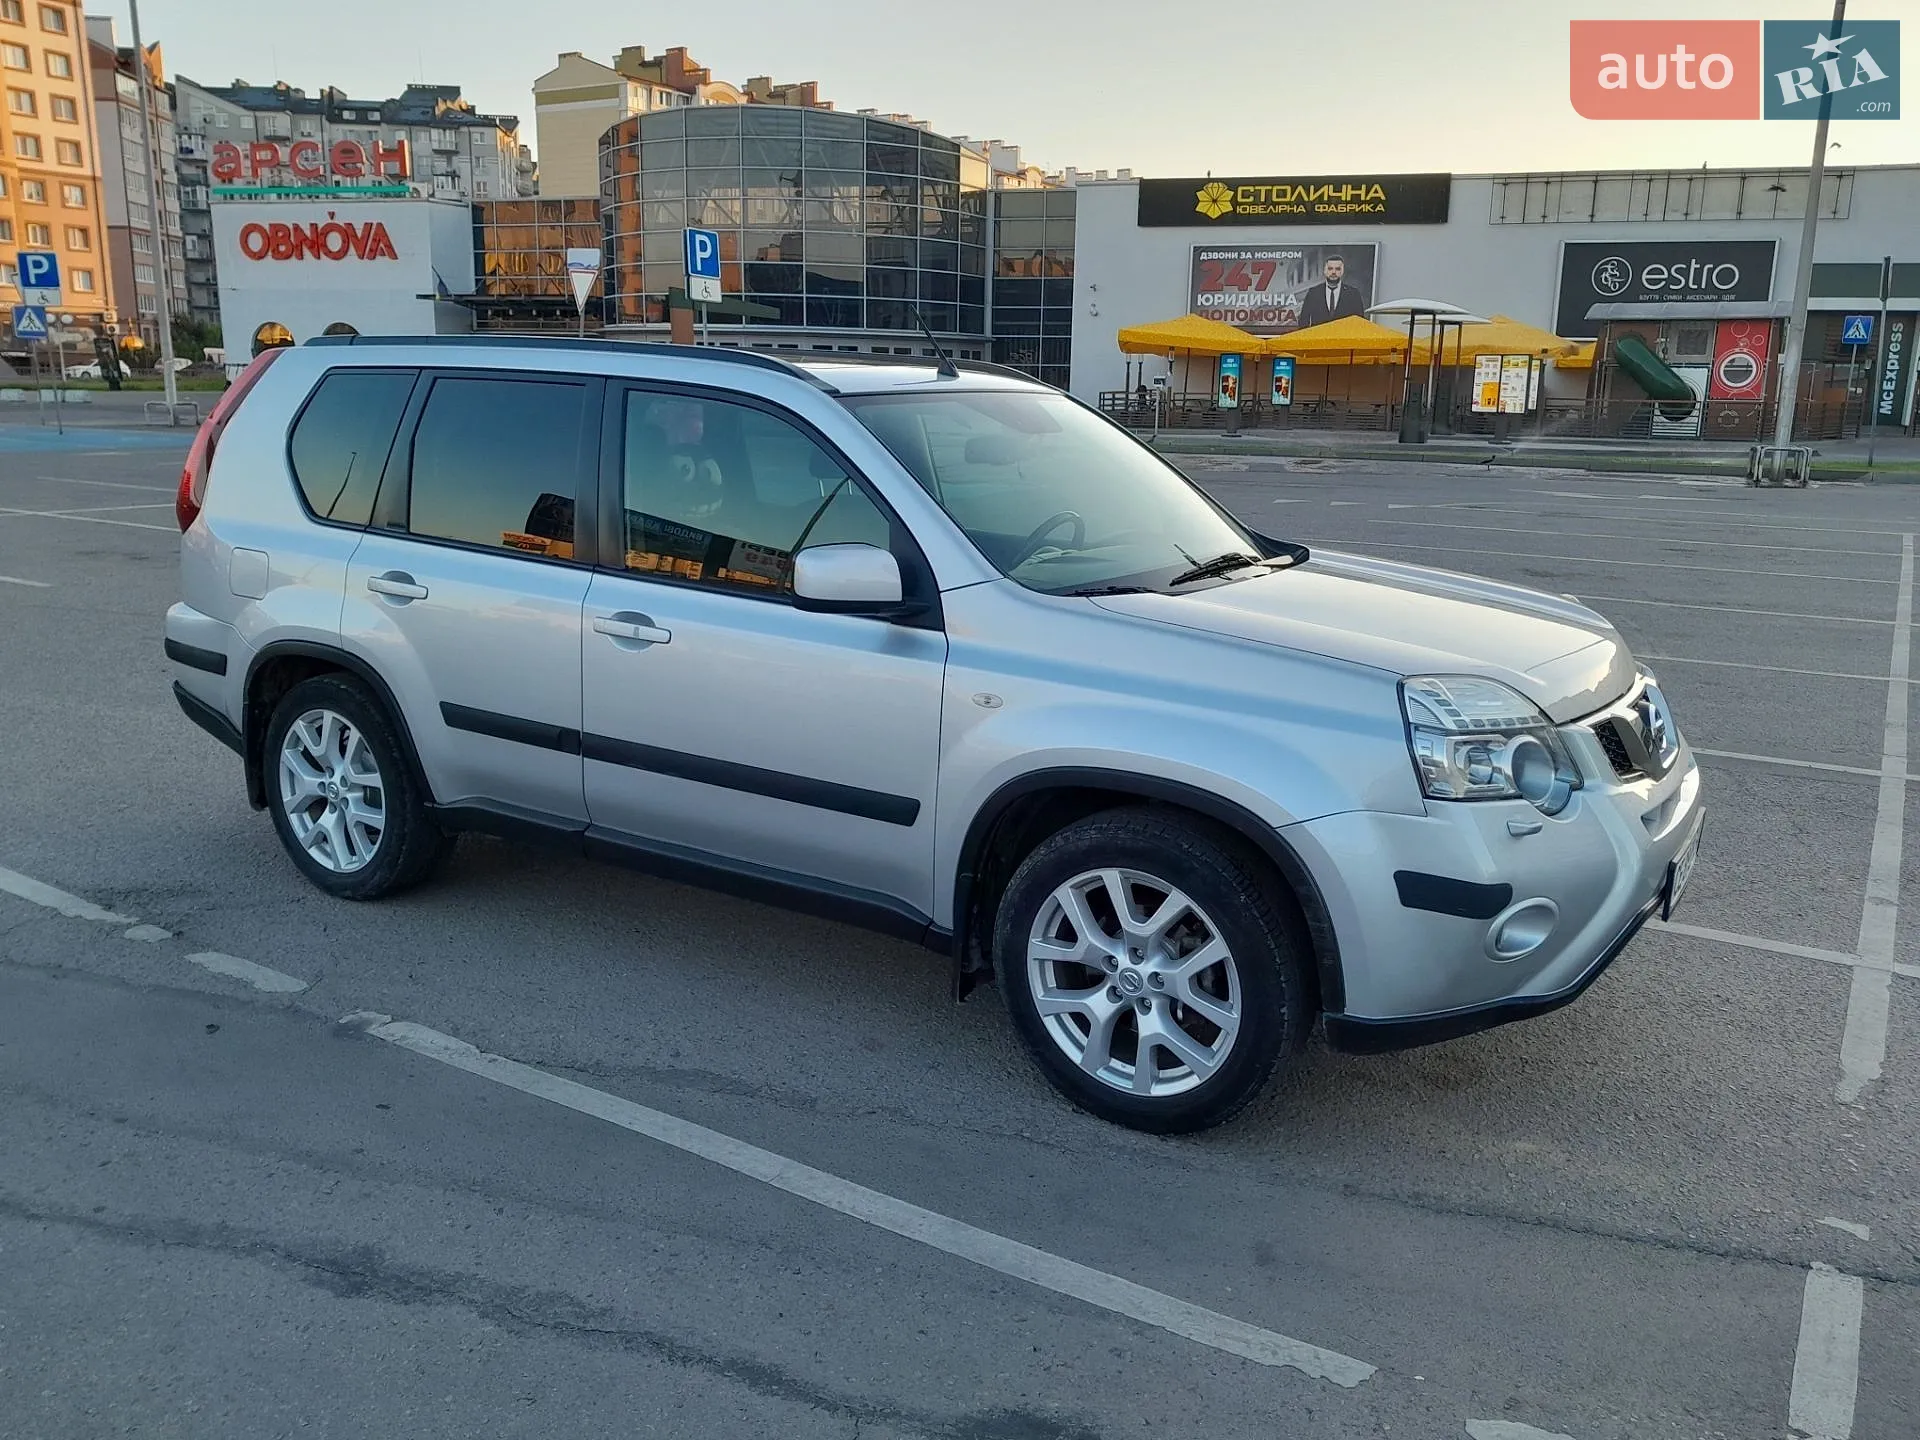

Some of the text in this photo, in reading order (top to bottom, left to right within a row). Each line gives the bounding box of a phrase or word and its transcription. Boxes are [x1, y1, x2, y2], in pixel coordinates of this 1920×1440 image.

[1236, 183, 1387, 203] СТОЛИЧНА
[1236, 203, 1386, 214] ЮВЕЛІРНА ФАБРИКА
[694, 233, 712, 271] P
[1200, 251, 1302, 260] ДЗВОНИ ЗА НОМЕРОМ
[26, 255, 49, 285] P
[1200, 260, 1277, 292] 247
[1641, 258, 1740, 290] estro
[1197, 293, 1298, 308] ЮРИДИЧНА
[1879, 322, 1904, 415] McExpress
